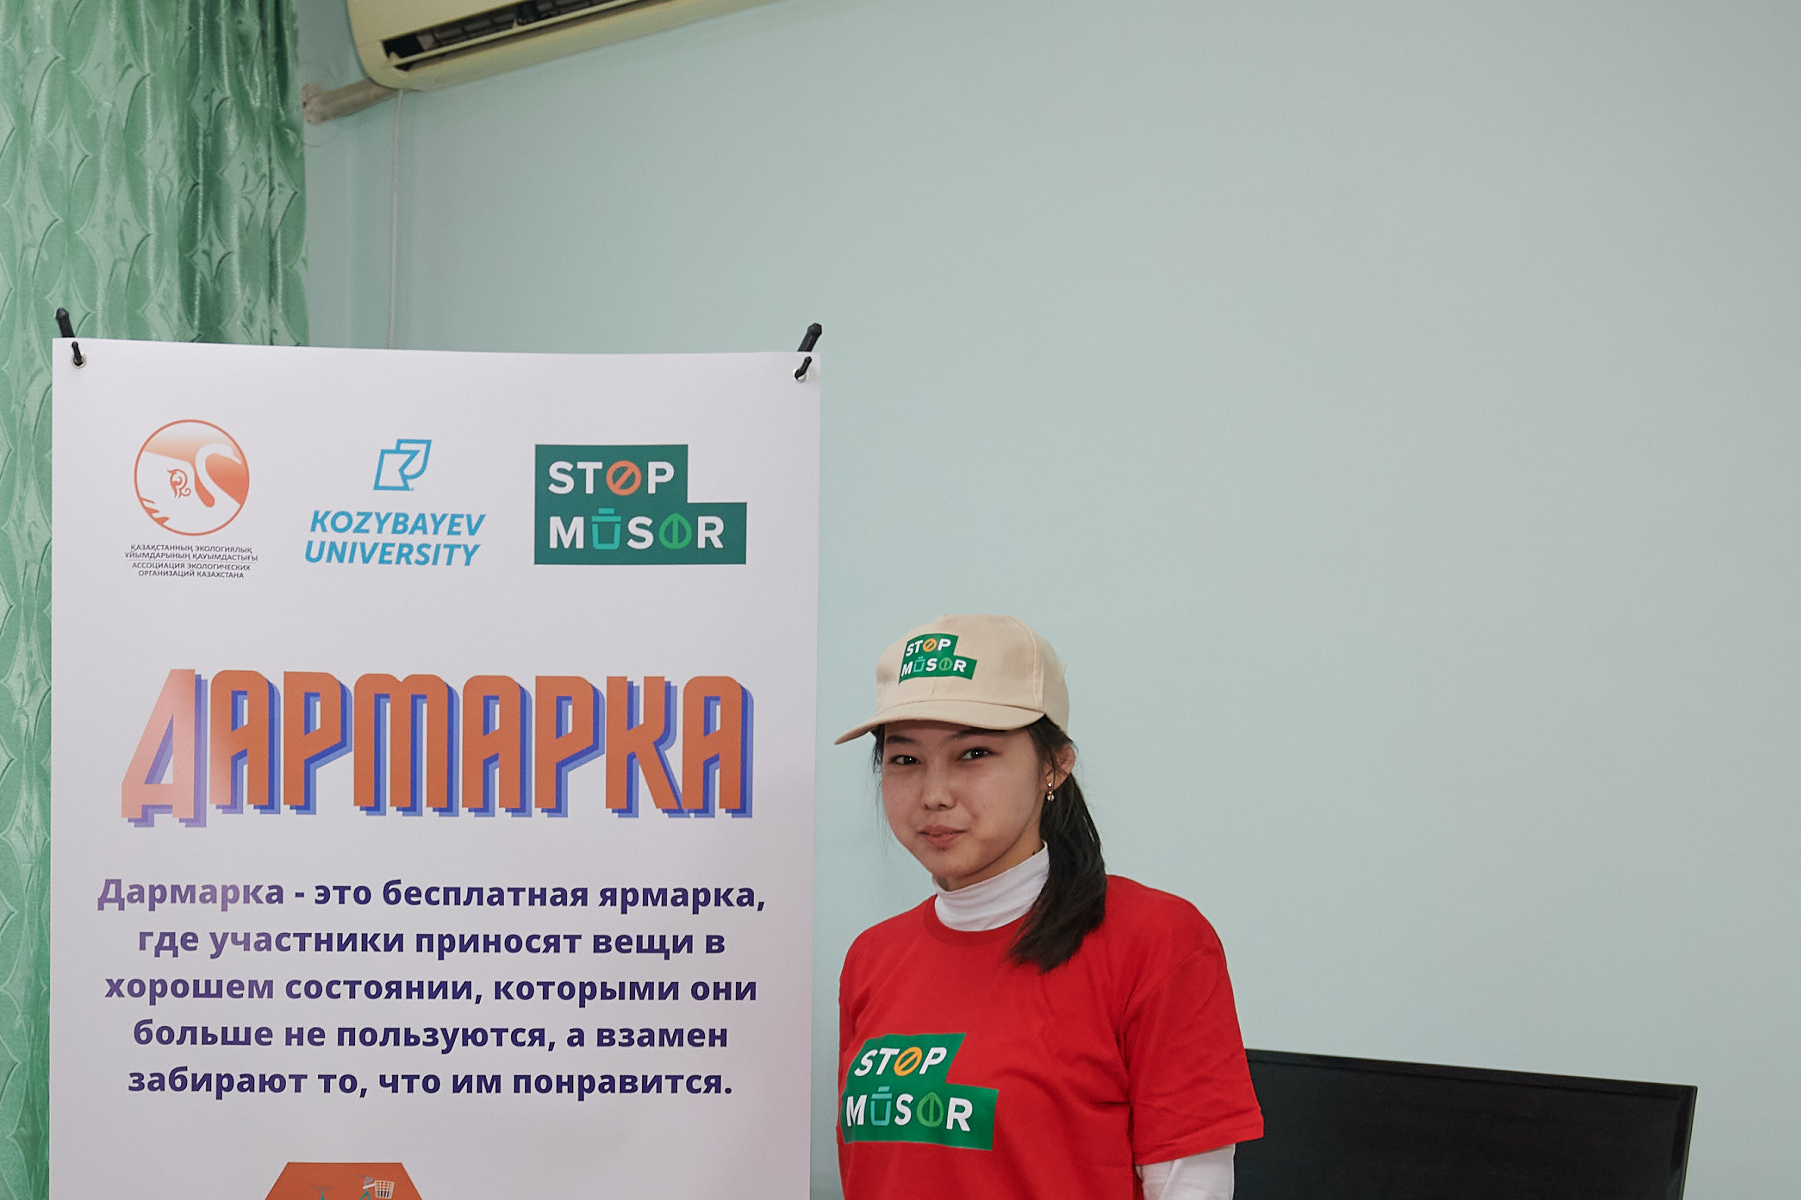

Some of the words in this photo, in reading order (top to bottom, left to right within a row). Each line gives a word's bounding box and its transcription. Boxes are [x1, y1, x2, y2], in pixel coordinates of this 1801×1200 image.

[548, 460, 675, 496] STOP
[309, 510, 486, 536] KOZYBAYEV
[132, 561, 185, 570] АССОЦИАЦИЯ
[187, 562, 251, 571] ЭКОЛОГИЧЕСКИХ
[305, 540, 481, 566] UNIVERSITY
[138, 569, 195, 578] ОРГАНИЗАЦИЙ
[196, 570, 245, 578] КАЗАХСТАНА
[905, 638, 951, 657] STOP
[121, 669, 754, 828] ДАРМАРКА
[98, 879, 284, 912] Дармарка
[314, 884, 372, 906] это
[383, 879, 589, 908] бесплатная
[599, 887, 765, 914] ярмарка,
[139, 931, 199, 958] где
[210, 931, 404, 960] участники
[416, 933, 583, 960] приносят
[593, 934, 694, 960] вещи
[706, 935, 726, 955] в
[105, 979, 274, 1006] хорошем
[286, 980, 483, 1005] состоянии,
[495, 981, 680, 1008] которыми
[691, 982, 757, 1002] они
[134, 1018, 274, 1047] больше
[285, 1027, 326, 1047] не
[338, 1027, 556, 1055] пользуются,
[567, 1028, 585, 1048] а
[597, 1028, 728, 1048] взамен
[854, 1046, 947, 1077] STOP
[128, 1066, 308, 1101] забирают
[318, 1074, 368, 1099] то,
[379, 1074, 441, 1095] что
[452, 1075, 502, 1095] им
[514, 1075, 733, 1102] понравится.
